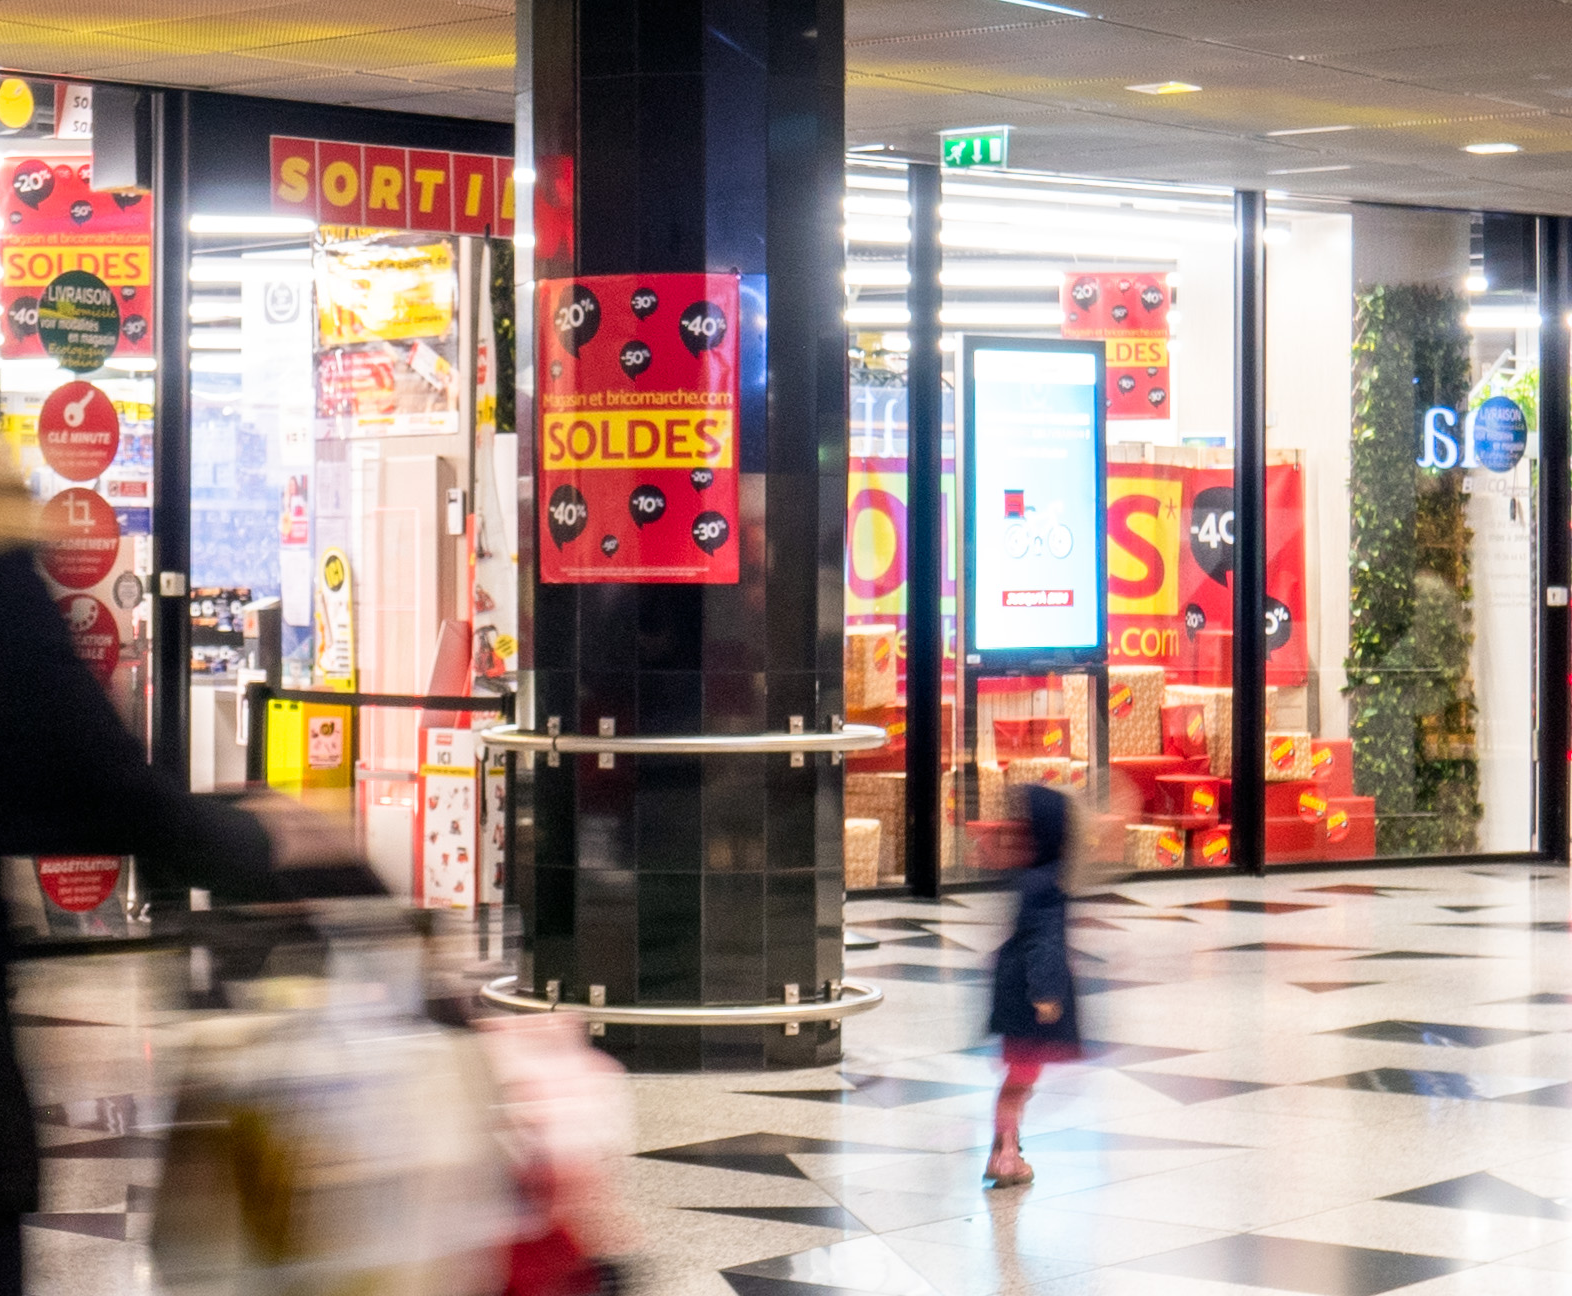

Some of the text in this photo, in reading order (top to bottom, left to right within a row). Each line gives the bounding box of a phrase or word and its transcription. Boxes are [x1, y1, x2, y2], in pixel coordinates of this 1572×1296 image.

[8, 252, 142, 280] SOLDES
[47, 285, 111, 306] LIVRAISON
[631, 295, 657, 310] -30%
[9, 308, 39, 325] -40
[555, 298, 595, 332] -20%
[681, 315, 727, 337] -40%
[620, 348, 651, 366] -50%
[589, 391, 603, 405] et
[606, 389, 733, 406] bricomarche.com
[548, 418, 722, 462] SOLDES
[549, 501, 588, 526] -40%
[632, 495, 666, 513] -10%
[692, 519, 727, 541] -30%
